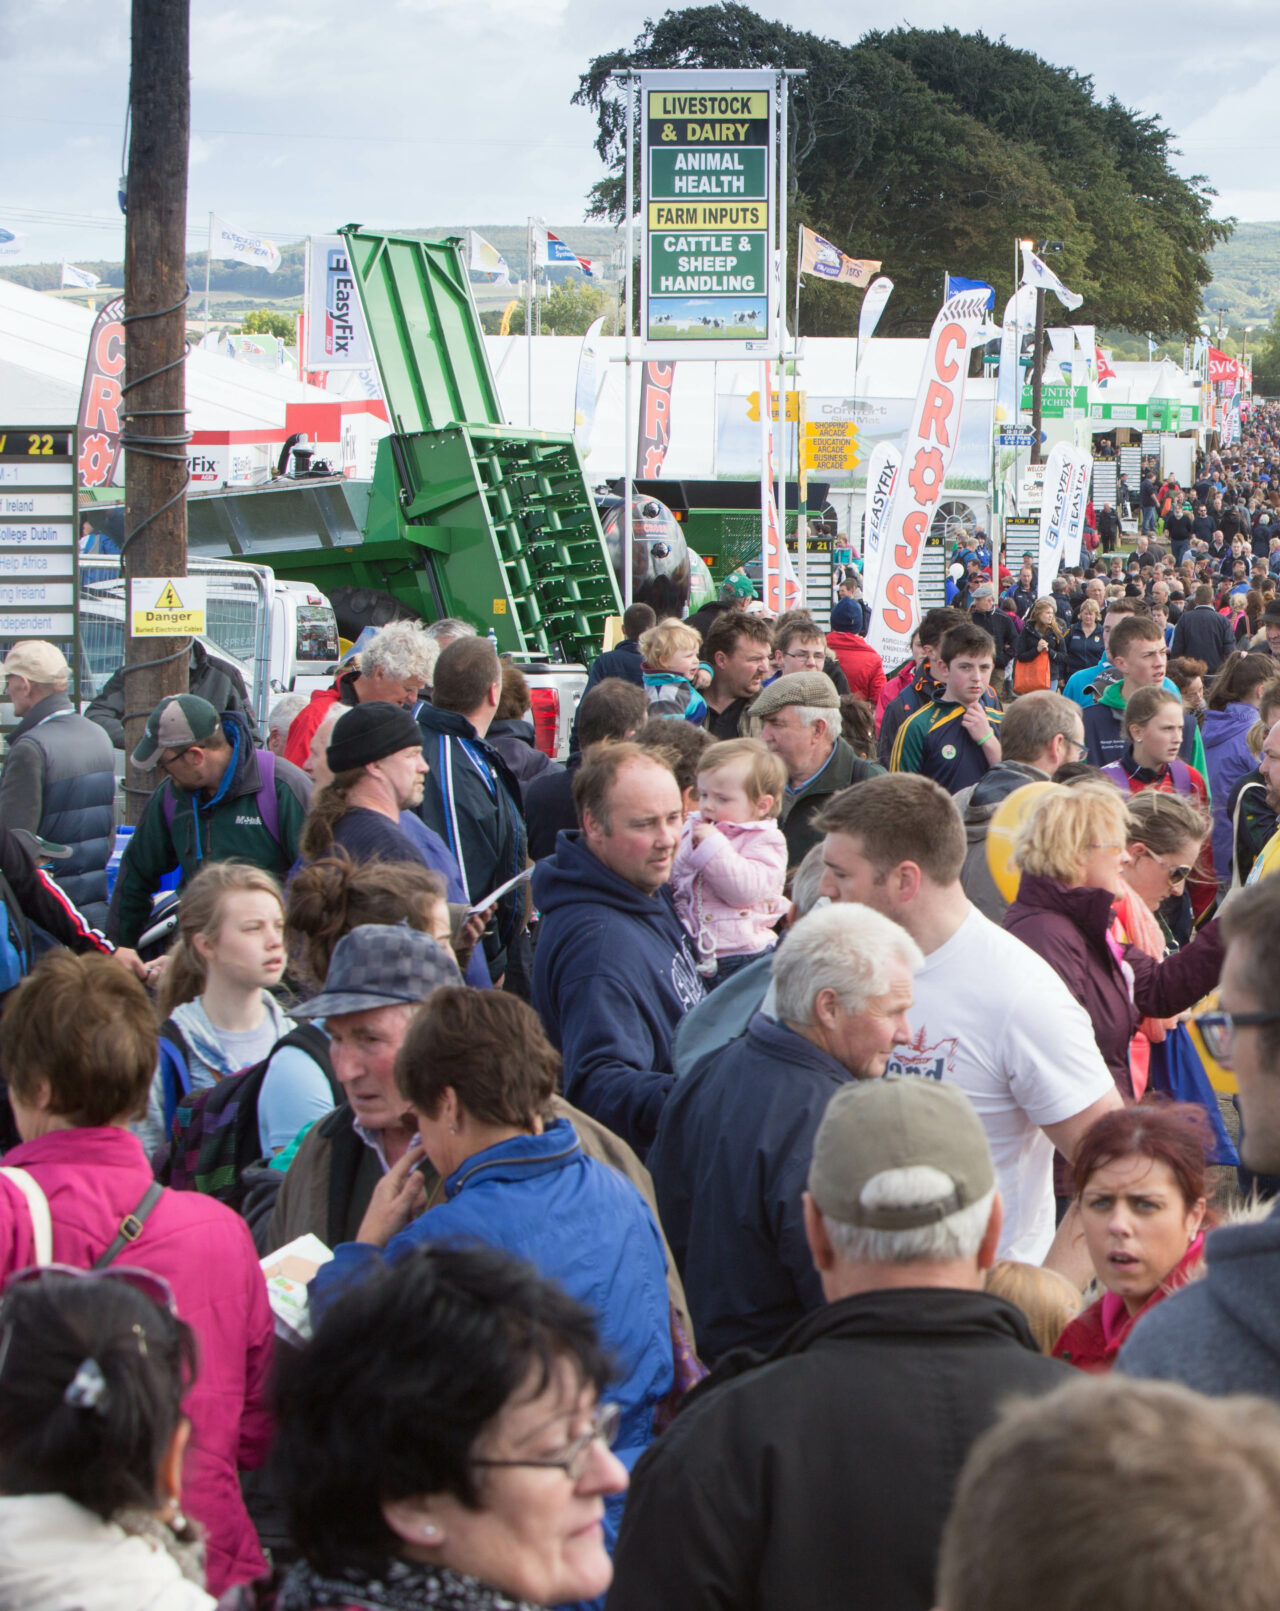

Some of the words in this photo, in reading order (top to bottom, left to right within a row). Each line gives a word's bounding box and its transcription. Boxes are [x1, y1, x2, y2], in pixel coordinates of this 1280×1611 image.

[662, 96, 752, 115] LIVESTOCK
[661, 122, 678, 142] &
[686, 122, 750, 142] DAIRY
[674, 152, 744, 171] ANIMAL
[674, 175, 745, 194] HEALTH
[657, 207, 698, 225] FARM
[703, 207, 760, 225] INPUTS
[663, 236, 733, 252] CATTLE
[738, 236, 752, 252] &
[678, 256, 738, 272] SHEEP
[660, 275, 756, 292] HANDLING
[330, 278, 354, 353] EasyFix
[1209, 360, 1236, 374] SVK
[814, 421, 849, 430] SHOPPING
[28, 434, 54, 455] 22
[812, 438, 851, 446] EDUCATION
[813, 454, 848, 462] BUSINESS
[869, 459, 897, 531] EASYFIX
[1051, 462, 1072, 527] EASYFIX
[6, 499, 34, 512] Ireland
[30, 527, 58, 542] Dublin
[793, 541, 813, 550] RW
[817, 542, 828, 550] 21
[22, 560, 48, 571] Africa
[16, 588, 46, 600] Ireland
[145, 611, 193, 622] Danger
